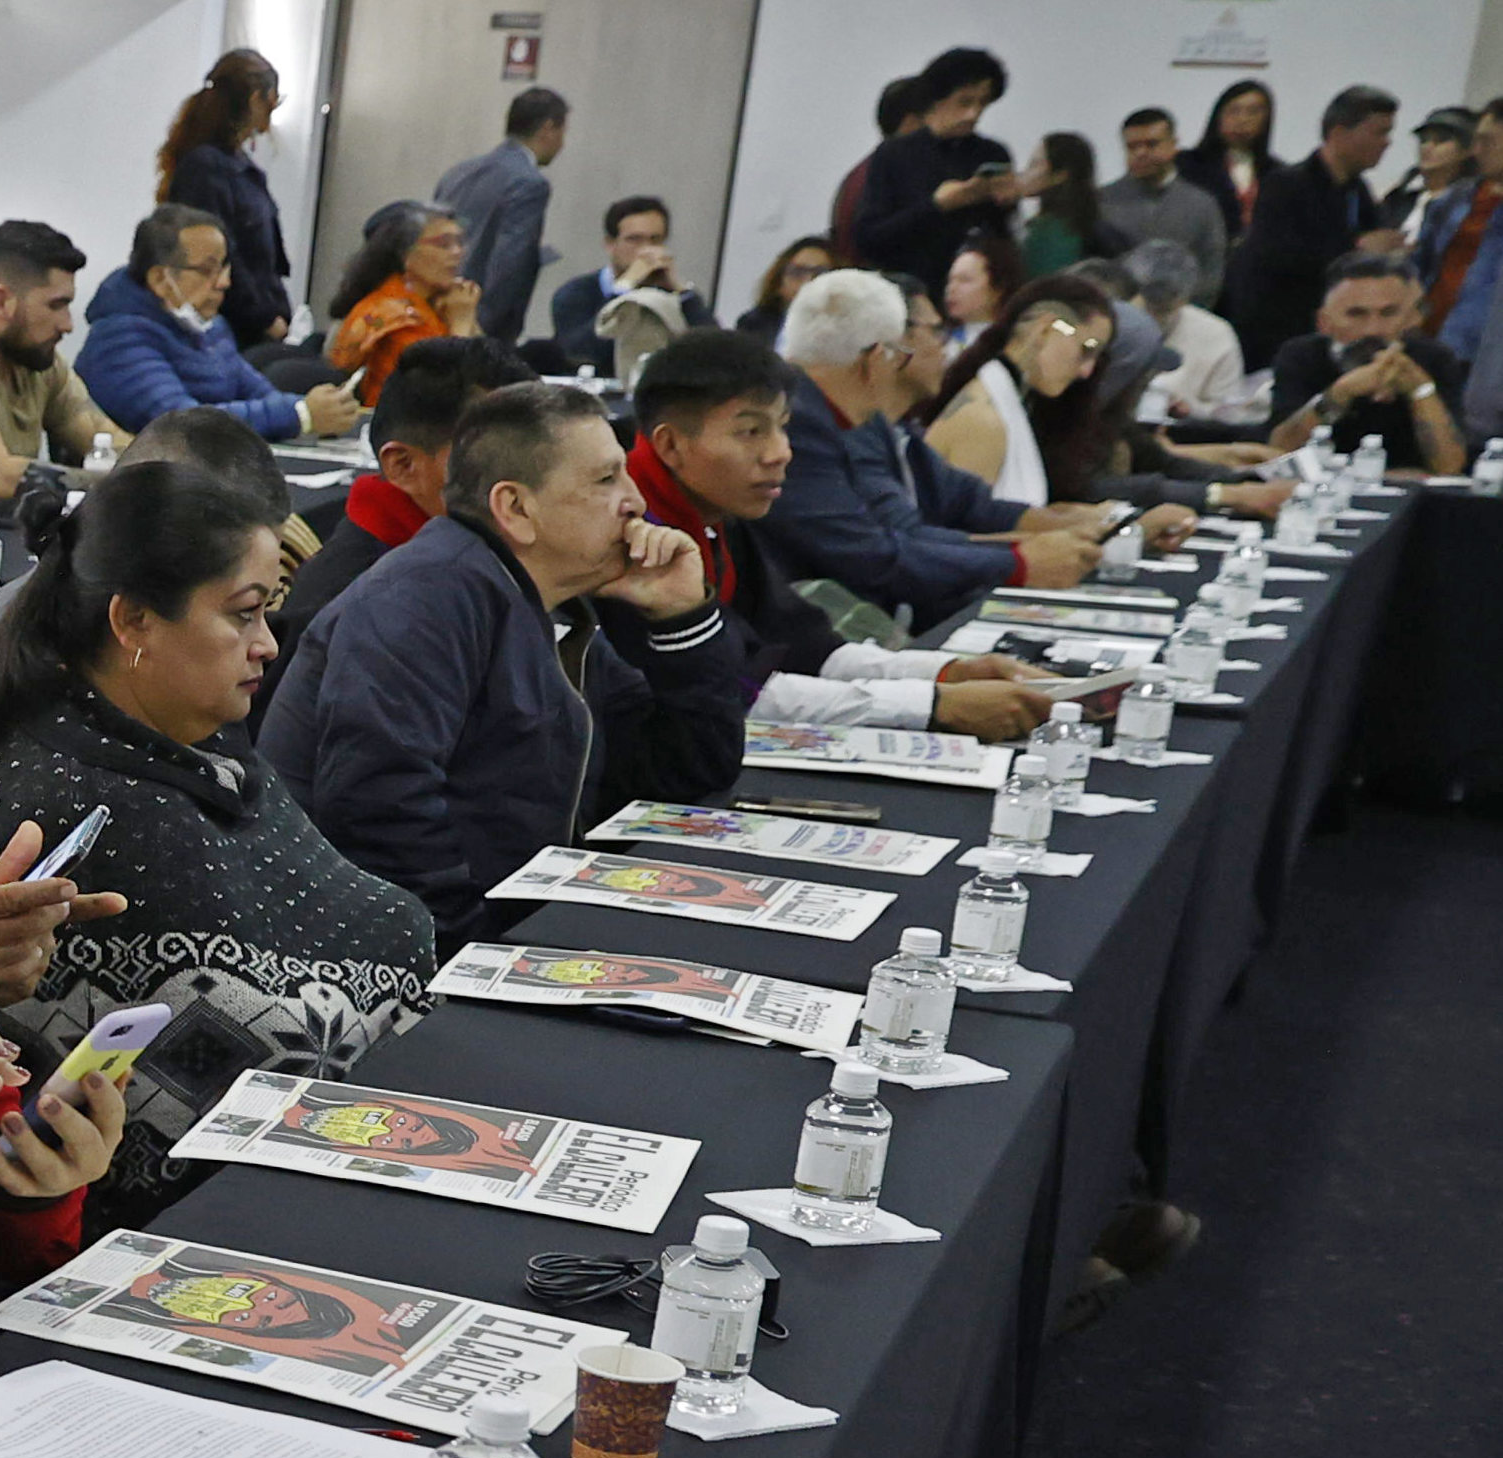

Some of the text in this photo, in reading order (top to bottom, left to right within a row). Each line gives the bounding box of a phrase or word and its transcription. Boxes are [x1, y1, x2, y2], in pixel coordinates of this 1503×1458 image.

[535, 1128, 663, 1209] EL CALLEJERO
[599, 1169, 649, 1213] Periódico
[397, 1307, 430, 1329] OCASO
[385, 1314, 577, 1414] EL CALLEJERO
